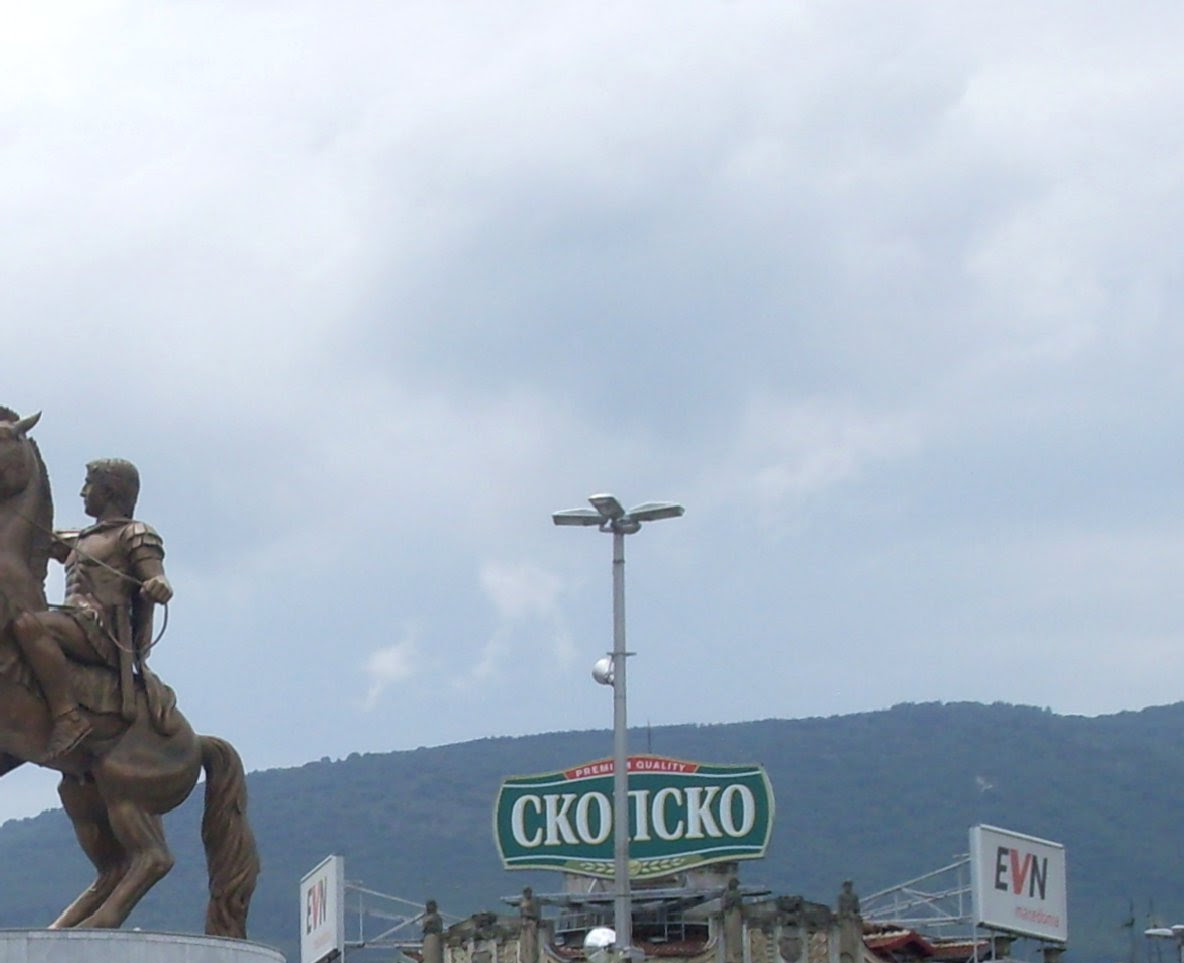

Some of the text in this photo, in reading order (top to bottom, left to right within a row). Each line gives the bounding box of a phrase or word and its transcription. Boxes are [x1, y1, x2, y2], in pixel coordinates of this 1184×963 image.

[575, 760, 686, 777] PREMI QUALITY
[995, 845, 1048, 900] EVN
[306, 876, 328, 935] EVN
